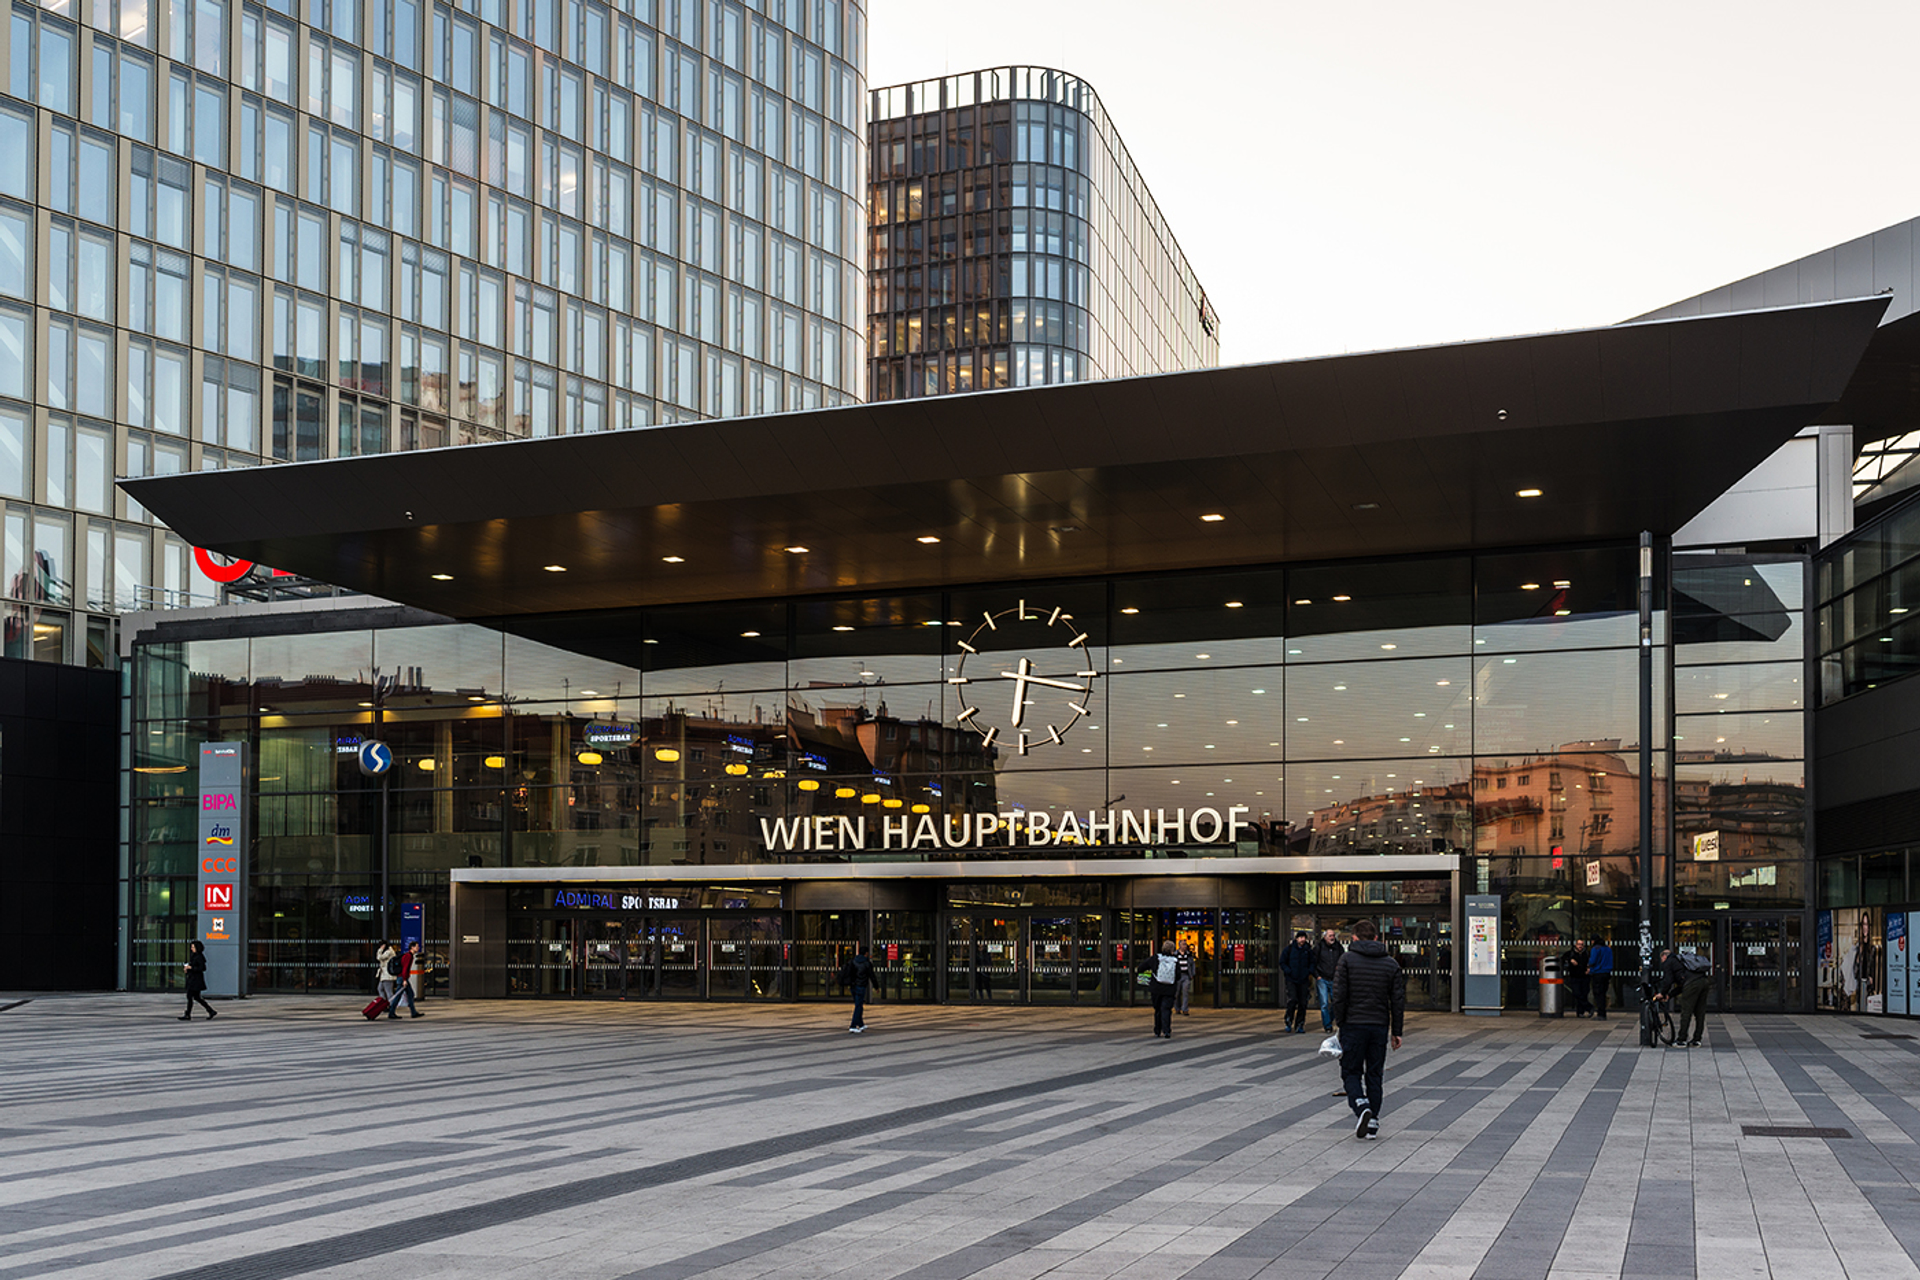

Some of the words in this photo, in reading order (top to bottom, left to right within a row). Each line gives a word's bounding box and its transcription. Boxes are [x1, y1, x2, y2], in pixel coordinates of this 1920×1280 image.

[202, 793, 237, 811] BIPA
[211, 823, 230, 837] dm
[760, 815, 867, 851] WIEN
[883, 807, 1250, 851] HAUPTBAHNHOF
[202, 857, 237, 873] CCC
[206, 886, 230, 903] IN
[554, 890, 617, 910] ADMIRAL
